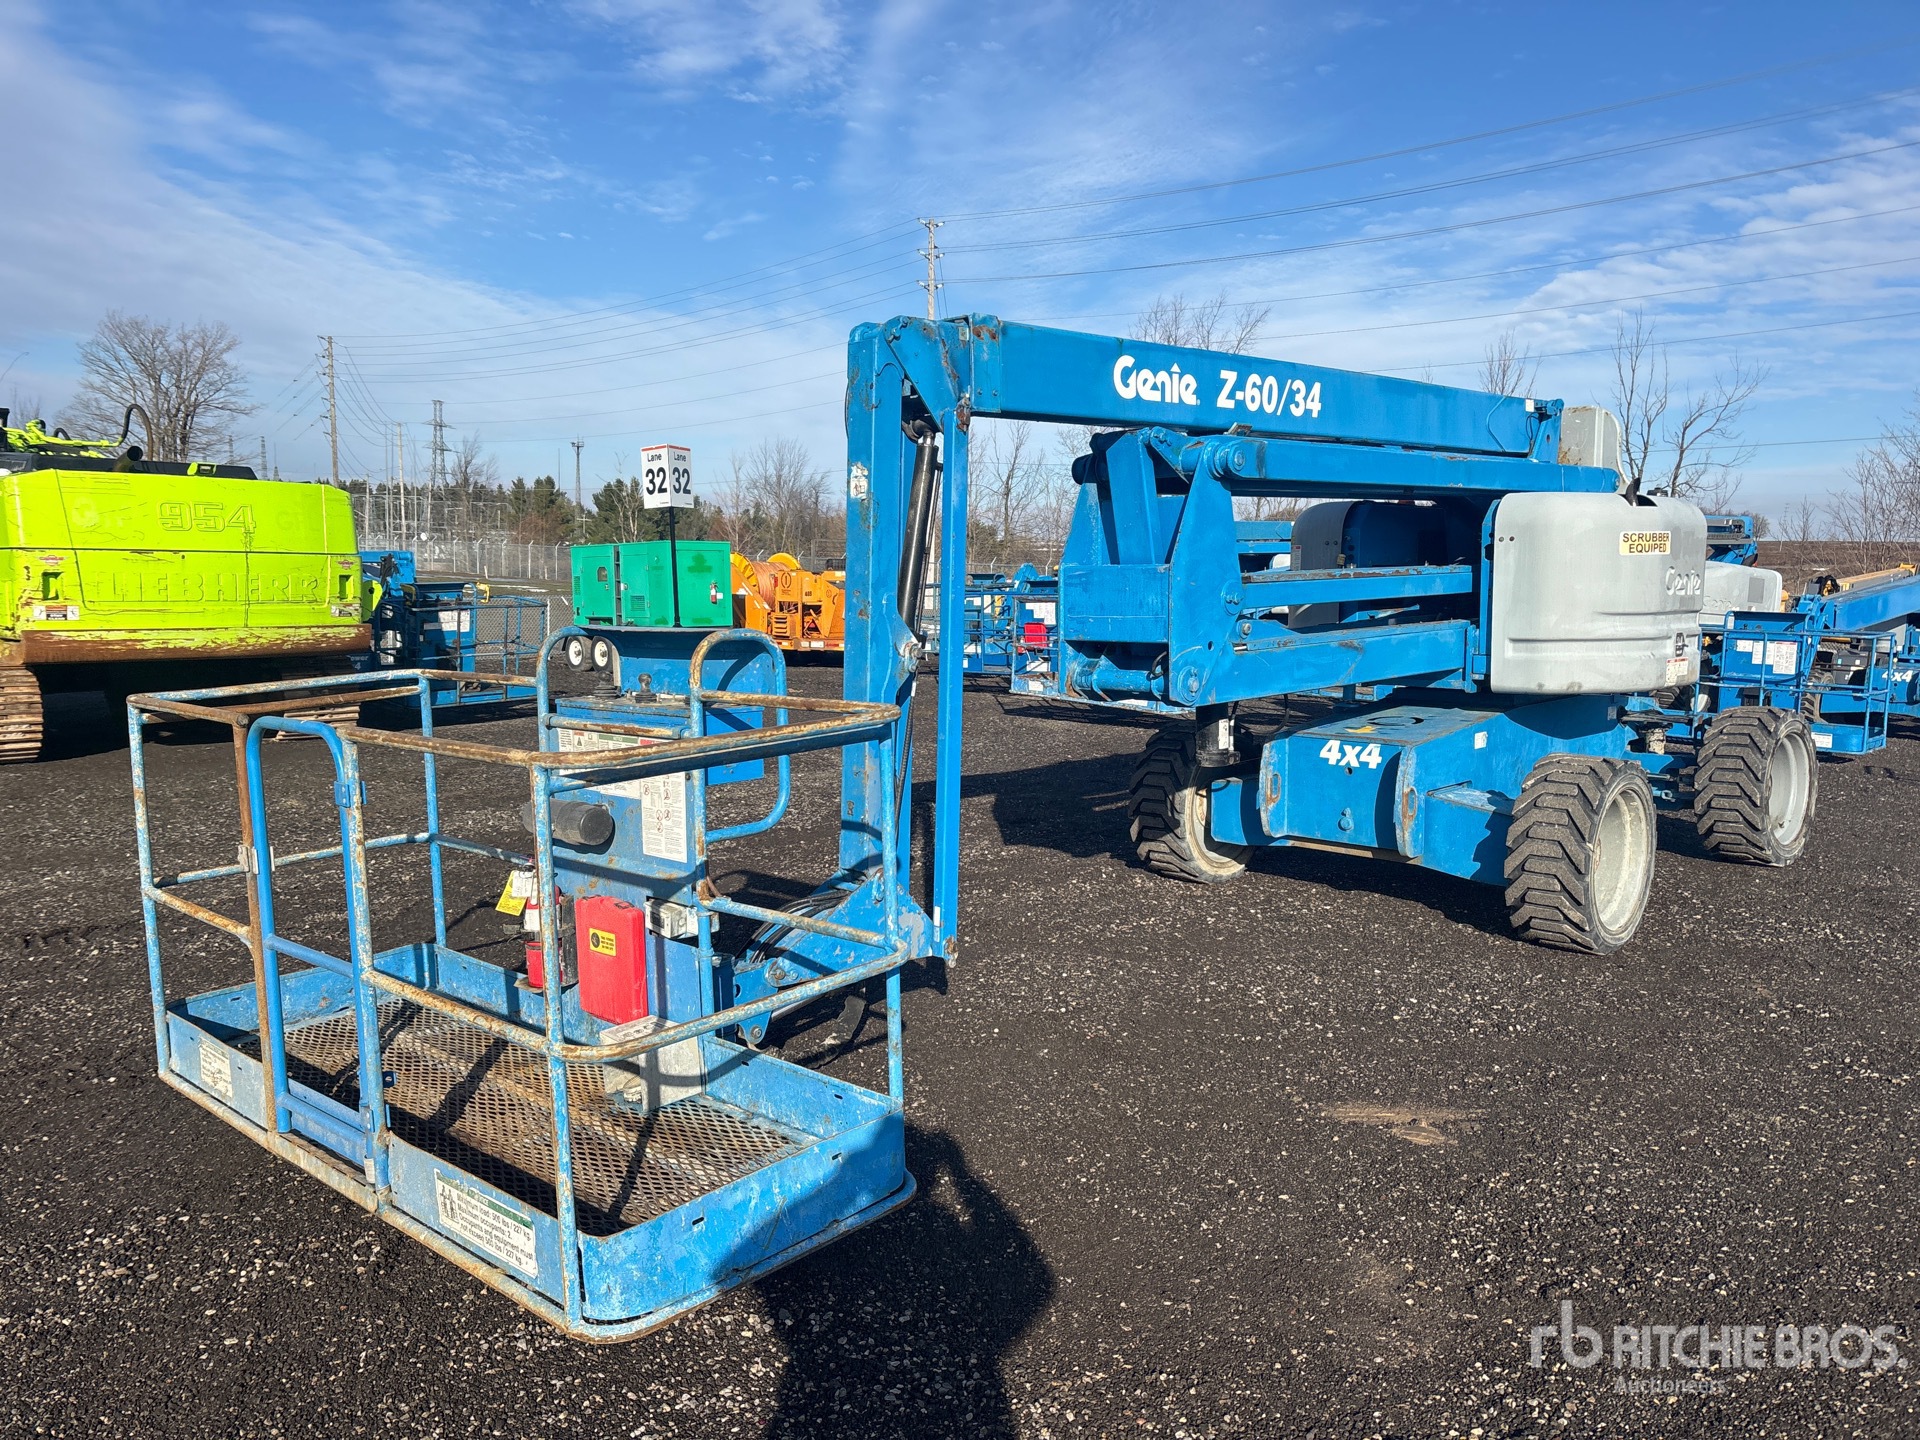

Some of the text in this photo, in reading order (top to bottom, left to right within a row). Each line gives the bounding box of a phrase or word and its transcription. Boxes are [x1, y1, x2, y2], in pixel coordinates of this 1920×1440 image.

[1113, 355, 1322, 418] Genie Z-60/34
[647, 452, 662, 462] Lane
[673, 451, 687, 462] Lane
[645, 466, 668, 495] 32
[672, 466, 691, 495] 32
[157, 500, 256, 534] 954
[1622, 532, 1670, 543] SCRUBBER
[1629, 542, 1667, 554] EQUIPED
[100, 572, 319, 602] LIEBHERR
[1665, 565, 1701, 596] Genie
[1881, 669, 1914, 683] 4x4
[1319, 739, 1383, 770] 4x4
[512, 1222, 523, 1236] 227
[504, 1247, 515, 1260] 227
